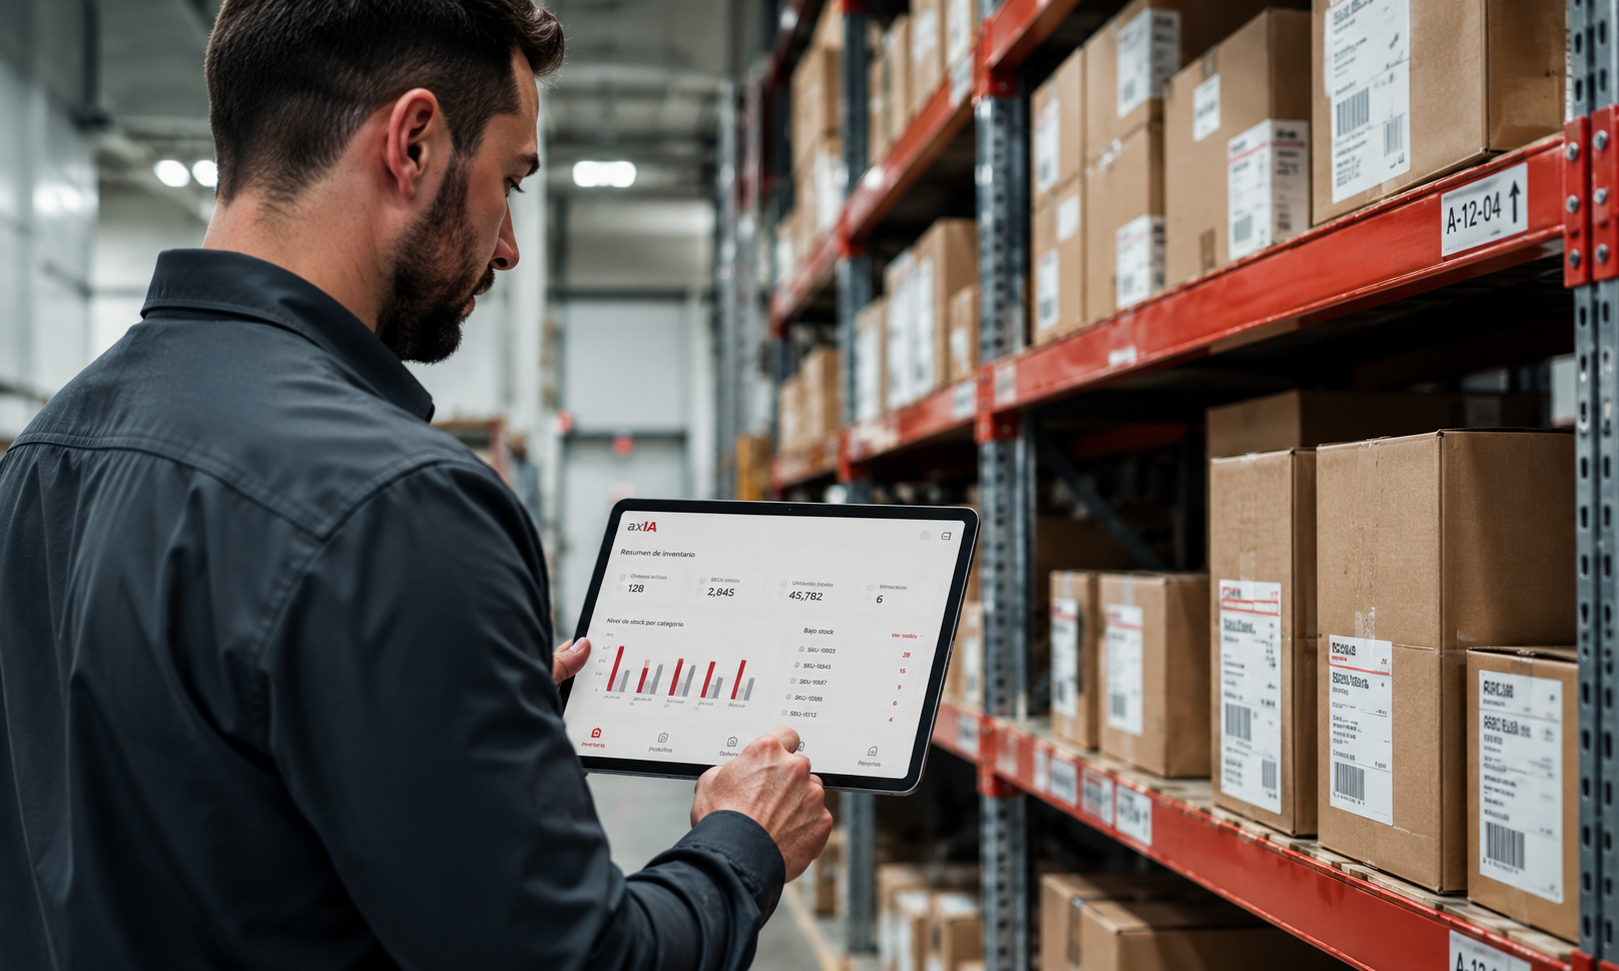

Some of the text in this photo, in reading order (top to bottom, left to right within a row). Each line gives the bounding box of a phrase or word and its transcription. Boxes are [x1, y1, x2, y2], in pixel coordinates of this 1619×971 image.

[1446, 191, 1502, 235] A-12-04
[627, 521, 657, 533] axIA
[620, 548, 696, 558] Resumen de inventario
[628, 583, 645, 593] 128
[707, 586, 735, 598] 2,845
[788, 590, 823, 602] 45,782
[876, 594, 884, 604] 6
[803, 627, 817, 635] Bajo
[899, 667, 907, 675] 15
